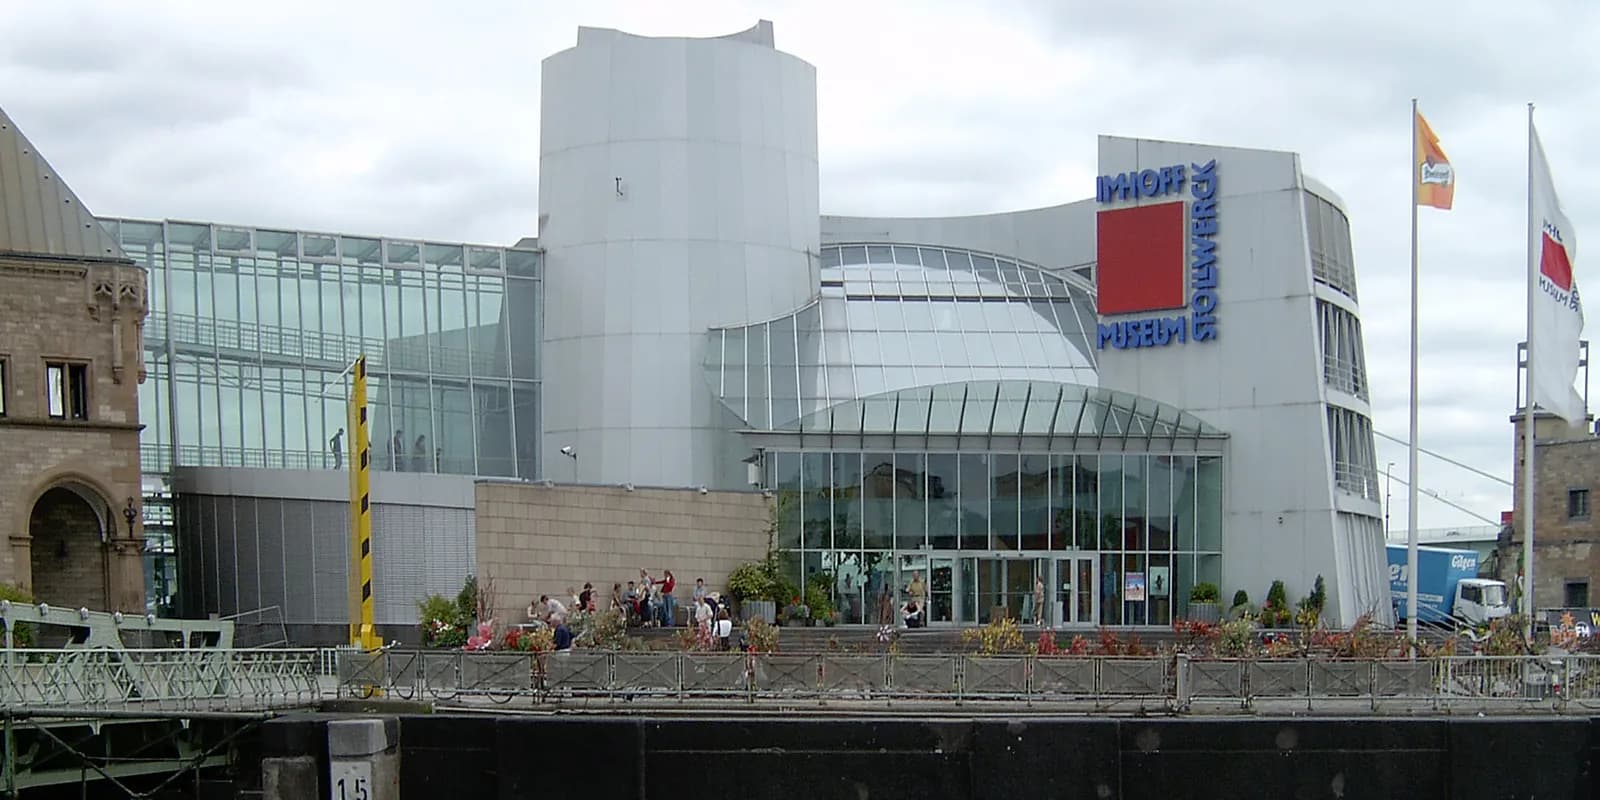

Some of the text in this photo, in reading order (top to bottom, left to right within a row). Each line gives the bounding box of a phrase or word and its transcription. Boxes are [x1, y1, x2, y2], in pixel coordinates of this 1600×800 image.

[1096, 165, 1185, 203] IMHOFF
[1096, 316, 1187, 350] MUSEUM
[338, 778, 368, 800] 15
